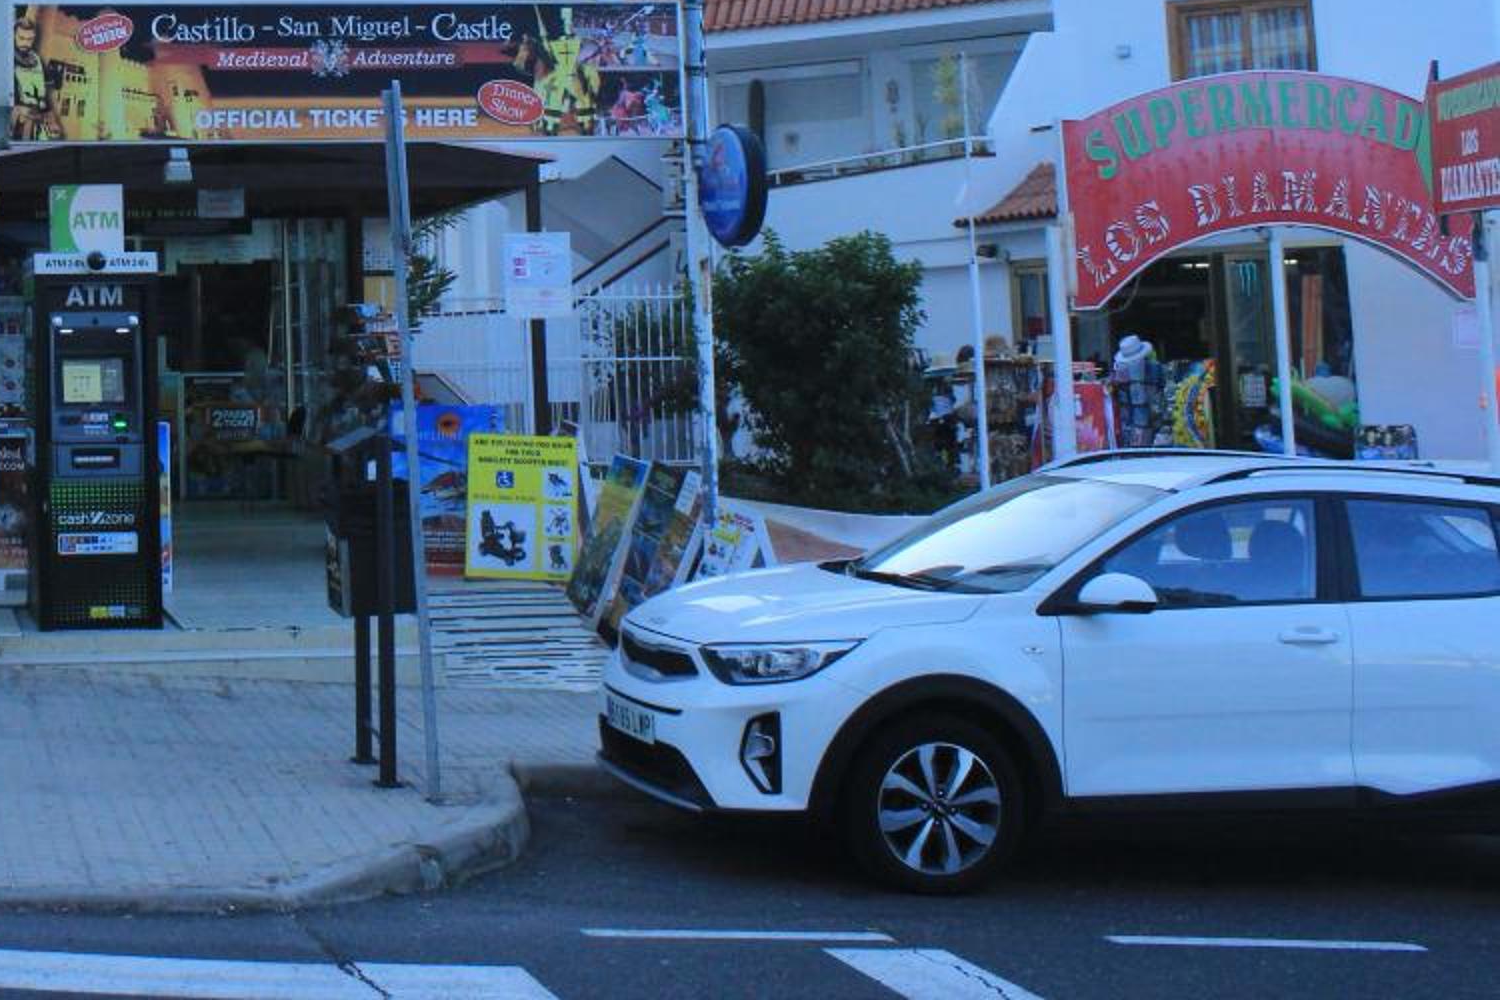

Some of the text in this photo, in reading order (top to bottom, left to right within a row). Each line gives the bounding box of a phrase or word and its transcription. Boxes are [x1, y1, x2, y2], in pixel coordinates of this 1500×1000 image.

[151, 13, 255, 44] Castillo
[277, 16, 320, 38] San
[331, 13, 410, 45] Miguel
[431, 12, 512, 43] Castle
[216, 48, 456, 69] Medieval Adventure
[493, 83, 539, 104] Dinner
[195, 108, 303, 130] OFFICIAL
[416, 107, 478, 127] HERE
[1085, 79, 1420, 181] SUPERMERCAD
[72, 210, 120, 231] ATM
[1076, 200, 1172, 287] LOS
[66, 284, 124, 307] ATM
